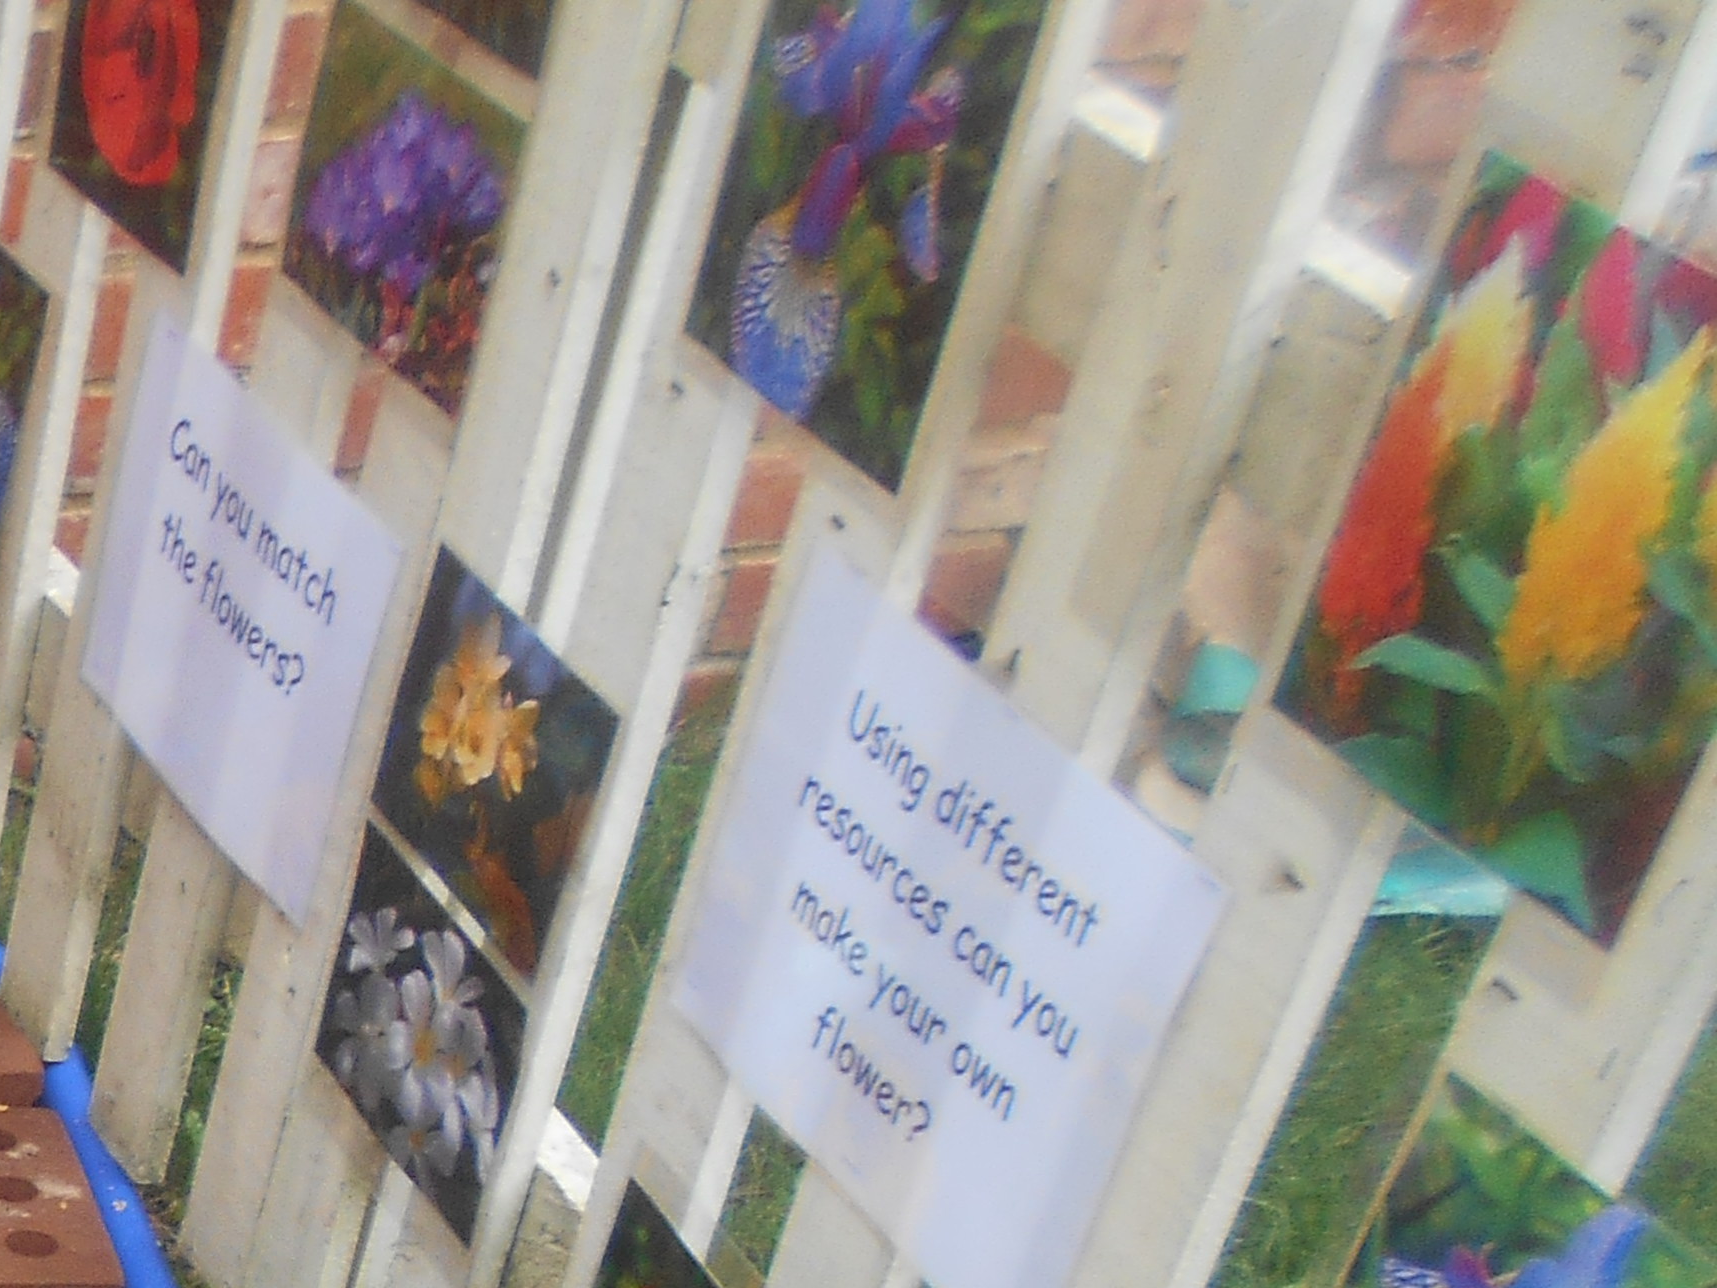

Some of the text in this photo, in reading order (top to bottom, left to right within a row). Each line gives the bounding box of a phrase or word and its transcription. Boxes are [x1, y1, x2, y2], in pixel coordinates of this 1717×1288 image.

[160, 512, 306, 697] the flowers?
[169, 417, 338, 628] Can you match
[797, 774, 1080, 1061] resources can you
[848, 688, 1100, 949] Using different
[790, 880, 1017, 1124] make your own
[810, 1003, 933, 1143] flower?
